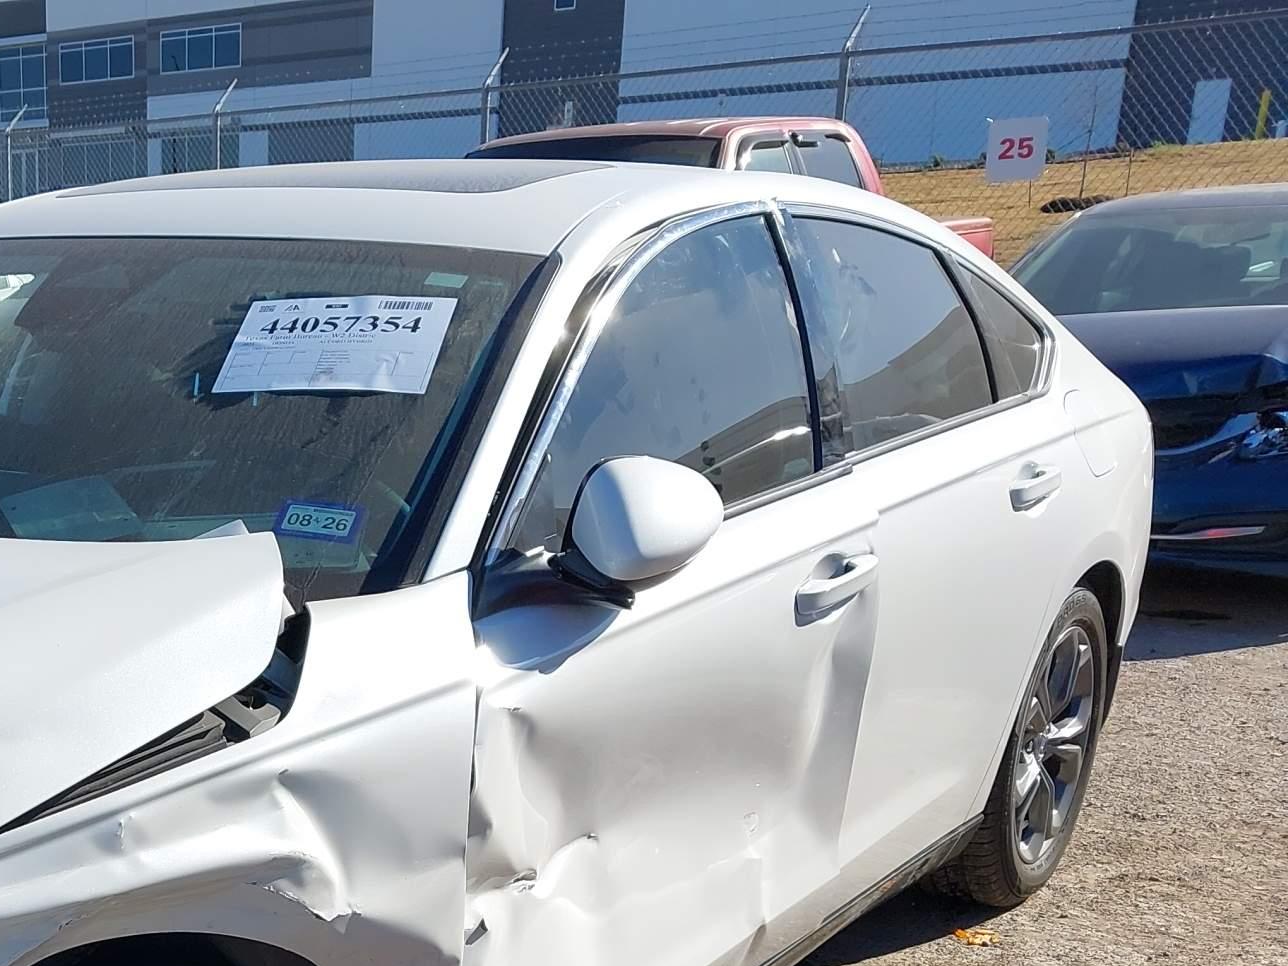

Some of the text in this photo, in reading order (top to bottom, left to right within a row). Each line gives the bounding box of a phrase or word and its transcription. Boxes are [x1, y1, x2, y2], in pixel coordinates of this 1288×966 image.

[998, 136, 1034, 160] 25
[260, 315, 422, 335] 44057354
[287, 512, 313, 527] 08
[321, 516, 349, 531] 26
